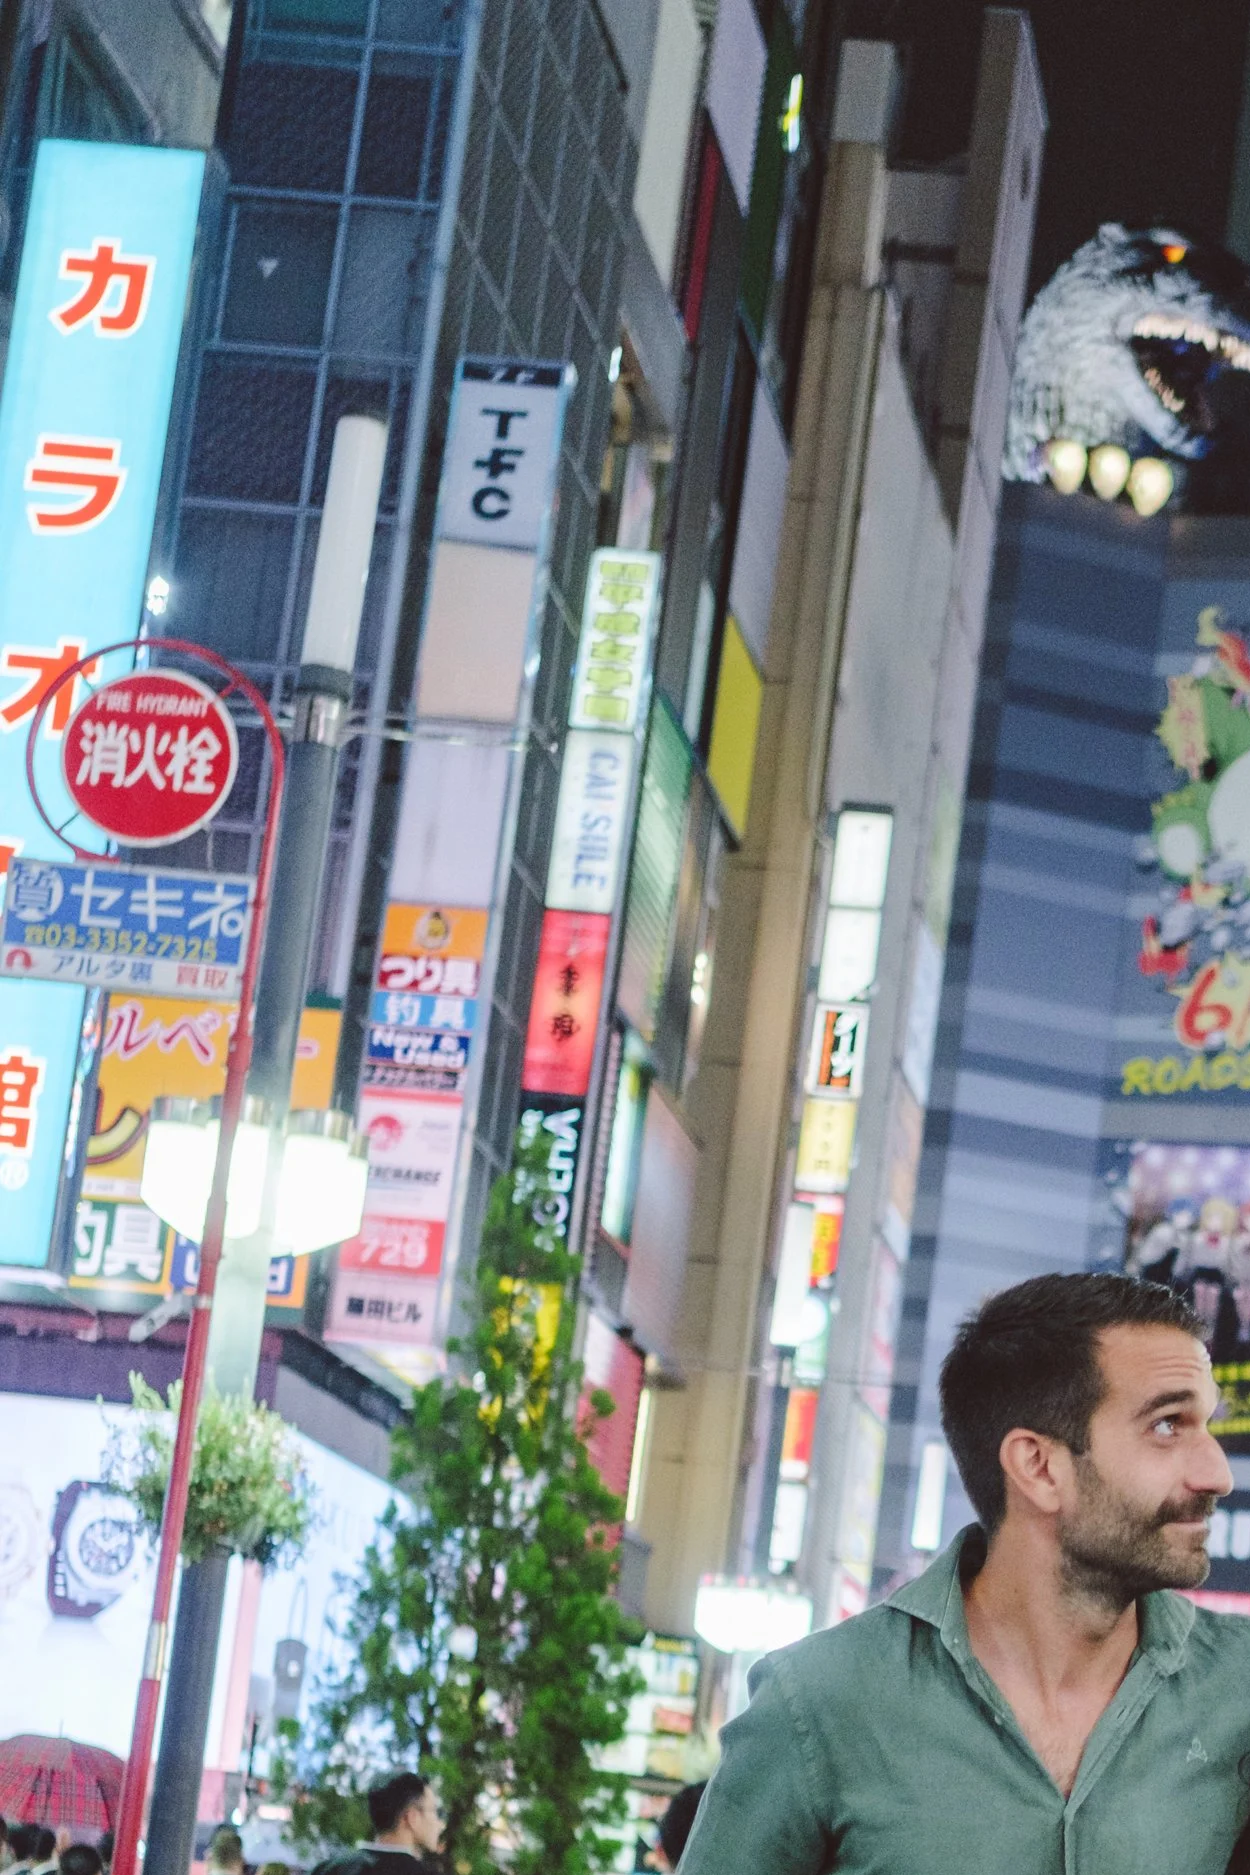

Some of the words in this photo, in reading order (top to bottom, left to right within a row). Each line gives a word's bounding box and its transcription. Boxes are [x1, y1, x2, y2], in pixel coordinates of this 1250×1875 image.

[0, 244, 152, 1149] カラオ
[97, 691, 131, 713] FIRE
[136, 694, 210, 718] HYDRANT
[76, 719, 222, 794] 消火栓
[70, 869, 246, 939] セキネ
[53, 953, 154, 982] アルタ裏
[379, 956, 478, 995] つり具
